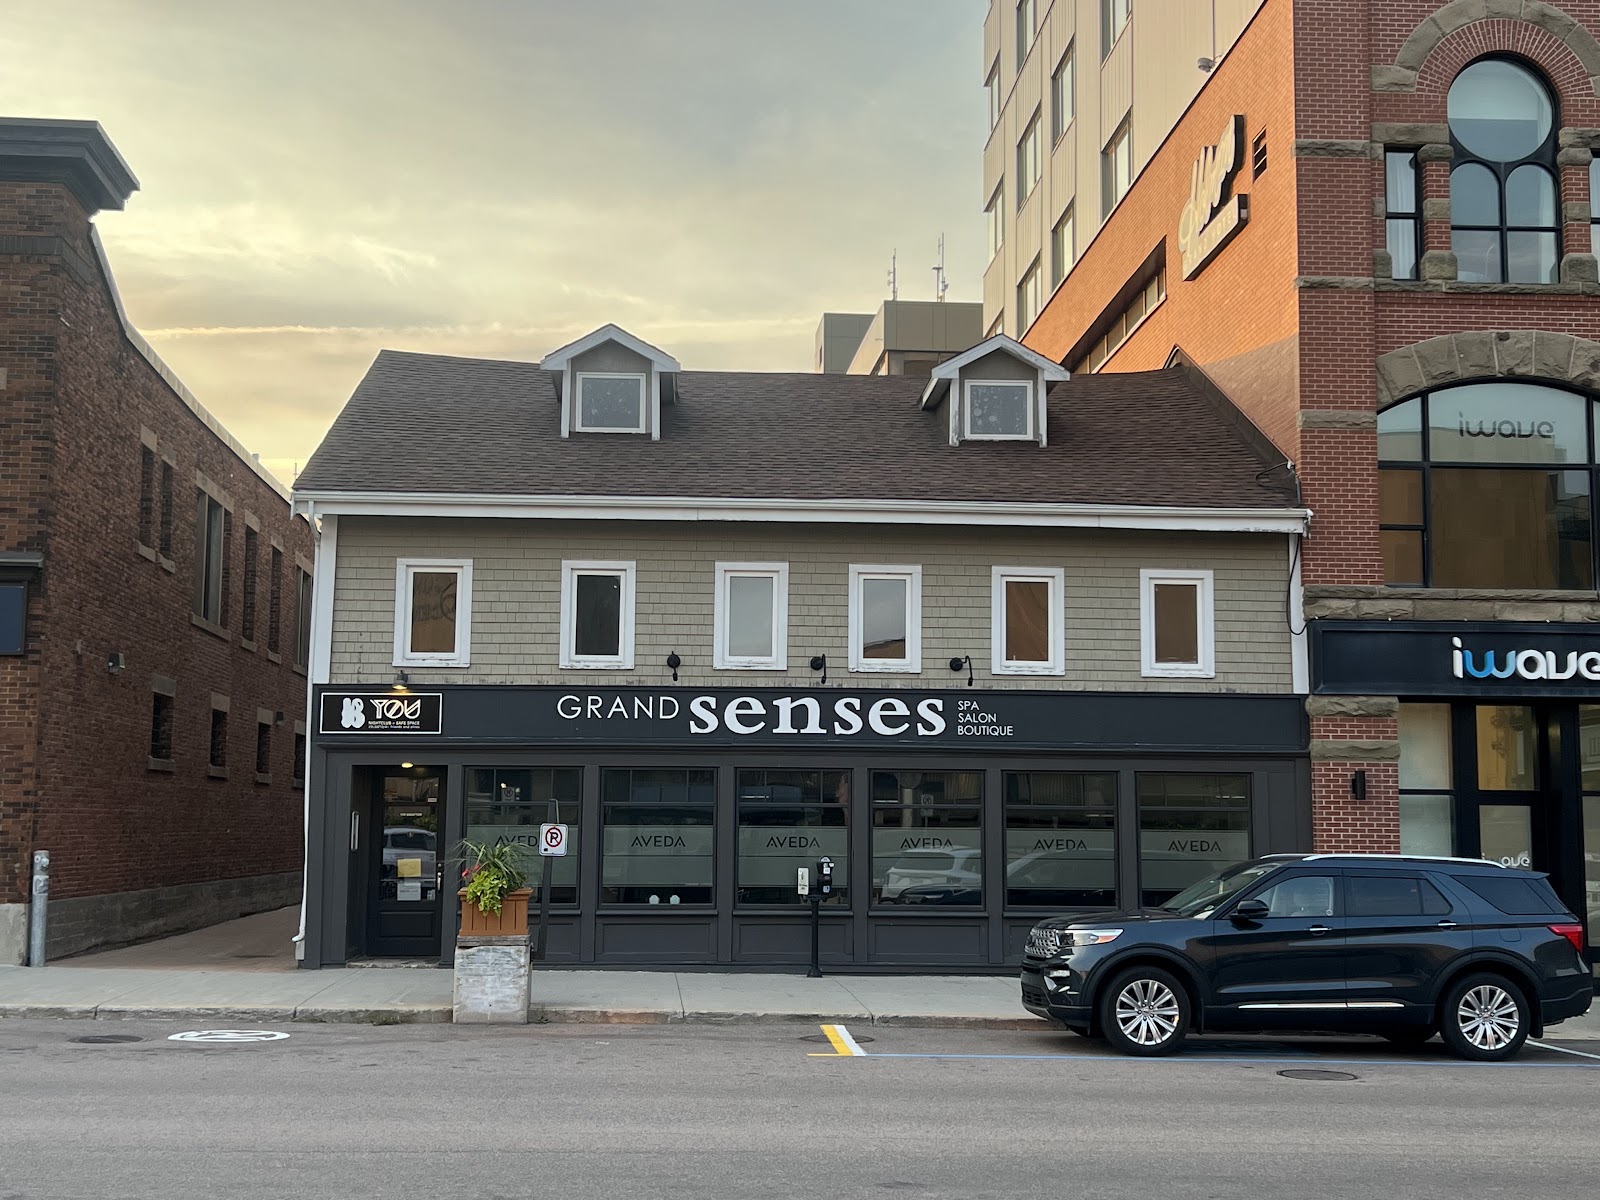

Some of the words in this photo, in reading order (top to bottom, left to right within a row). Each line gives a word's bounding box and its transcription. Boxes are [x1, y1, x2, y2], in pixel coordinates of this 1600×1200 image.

[1459, 411, 1554, 438] iwave
[1452, 636, 1600, 680] iwave
[370, 699, 421, 719] YOU
[958, 700, 980, 711] SPA
[557, 695, 679, 719] GRAND
[689, 696, 946, 736] senses
[958, 712, 997, 723] SALON
[958, 725, 1014, 737] BOUTIQUE
[495, 835, 540, 848] AVED
[631, 835, 686, 848] AVEDA
[766, 836, 820, 848] AVEDA
[900, 838, 953, 849] AVEDA
[1033, 839, 1087, 850] AVEDA
[1168, 840, 1222, 852] AVEDA
